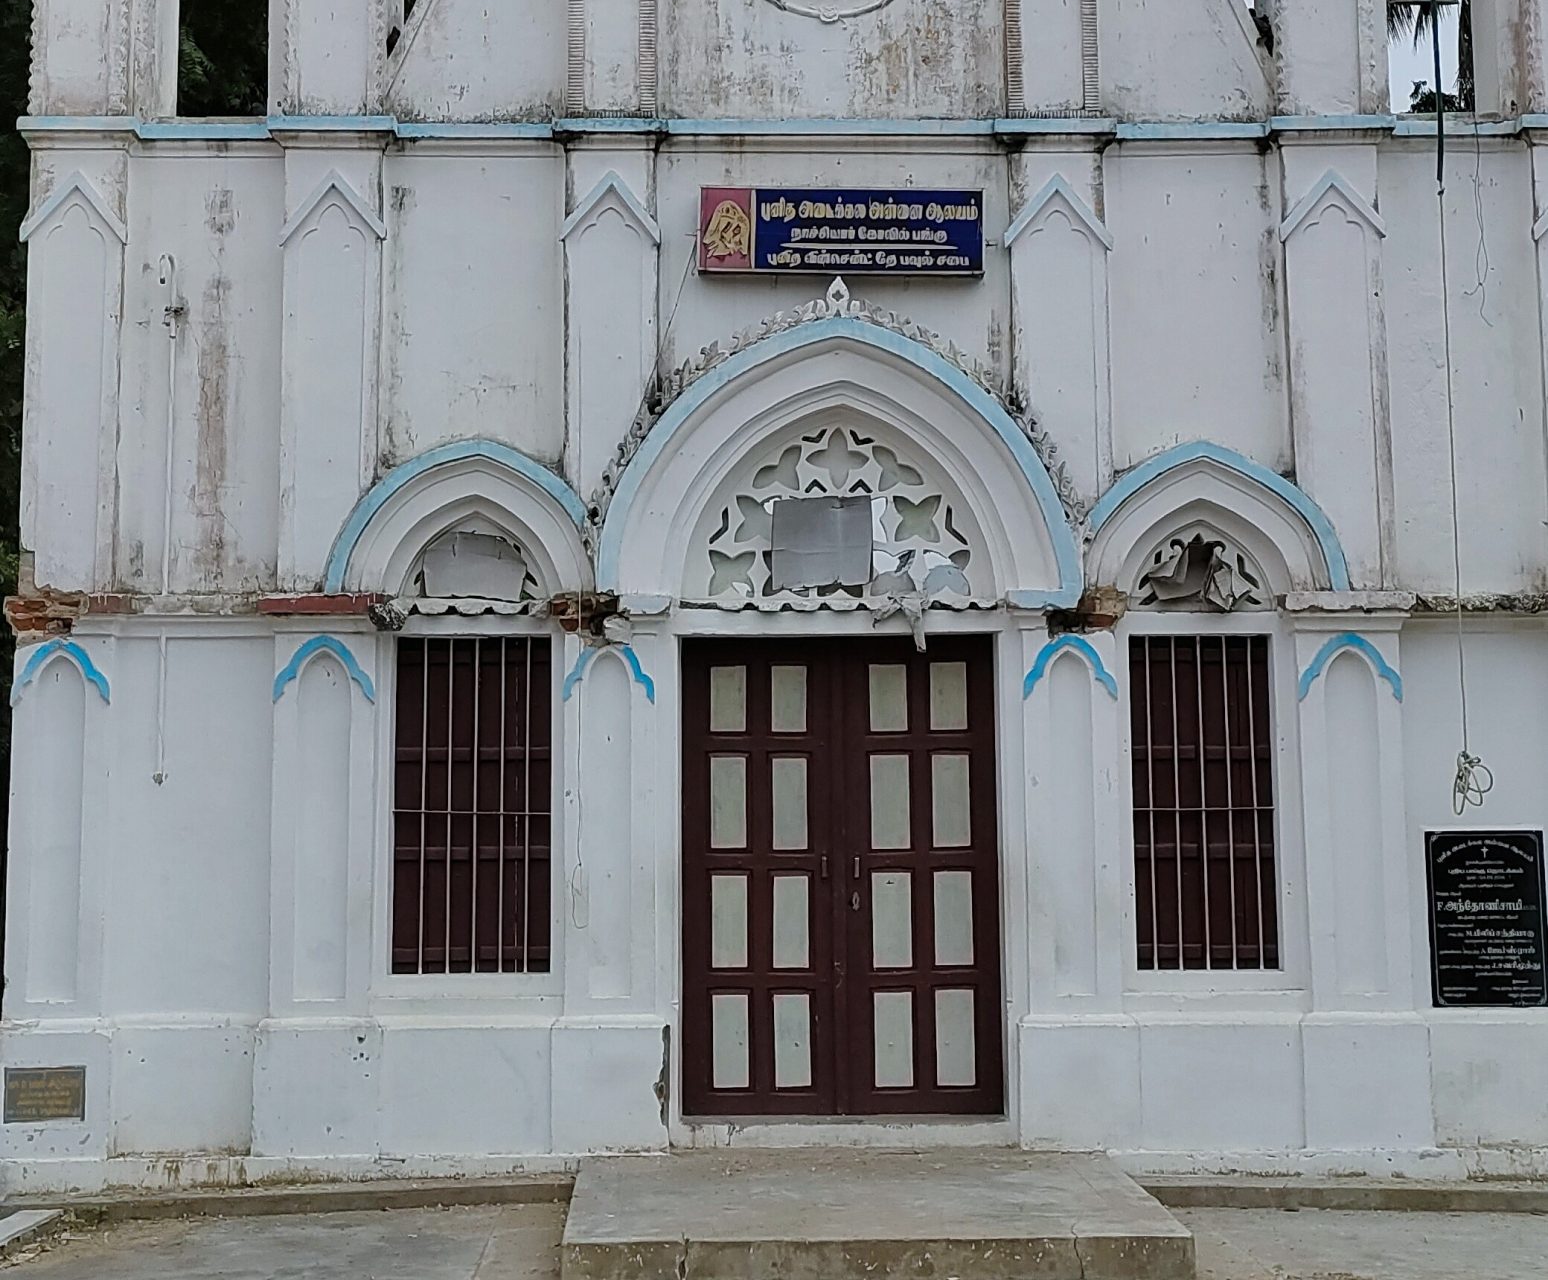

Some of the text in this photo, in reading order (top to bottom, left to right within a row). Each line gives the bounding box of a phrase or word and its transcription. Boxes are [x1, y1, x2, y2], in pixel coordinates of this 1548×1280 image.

[761, 196, 796, 223] புனித
[925, 197, 978, 223] ஆலயம்
[791, 226, 948, 243] நாச்சியார் கோவில் பங்கு
[767, 249, 801, 268] புனித
[936, 255, 969, 266] சபை
